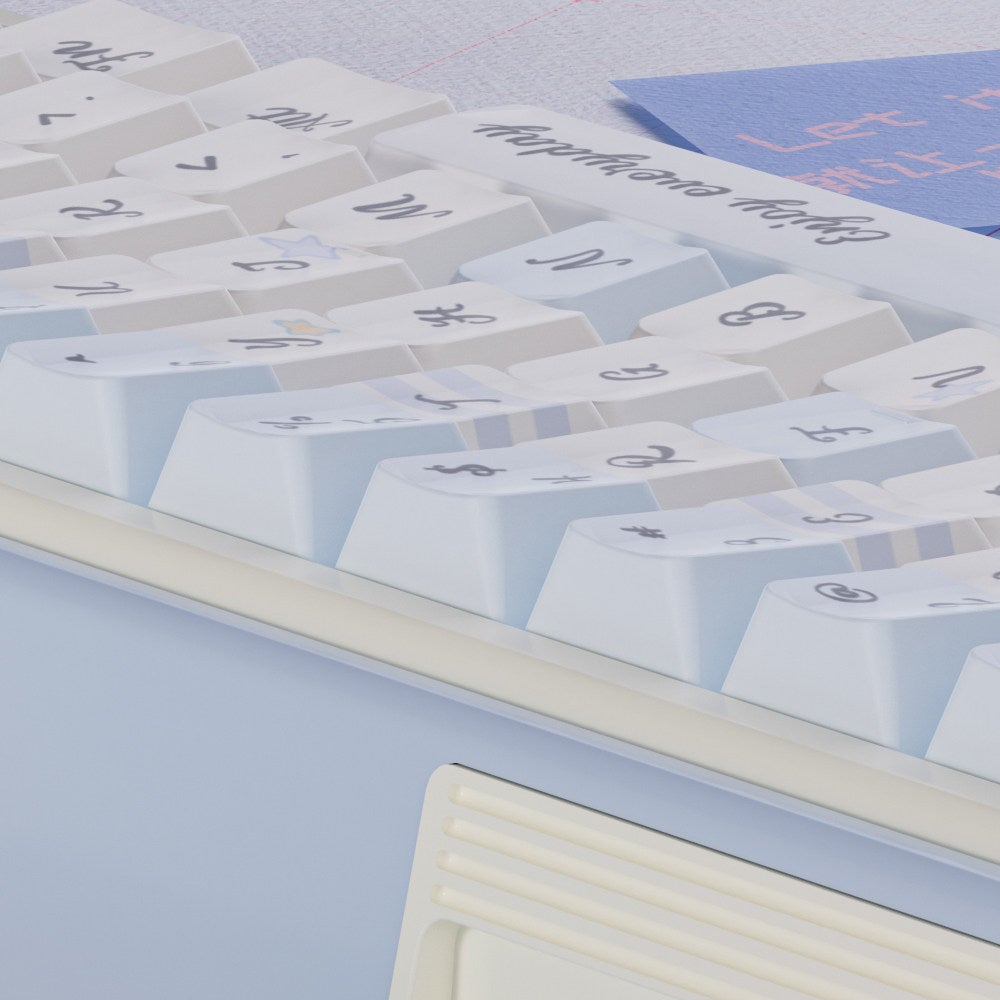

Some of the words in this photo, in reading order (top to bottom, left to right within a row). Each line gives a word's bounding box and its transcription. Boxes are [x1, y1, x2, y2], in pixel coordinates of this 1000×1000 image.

[247, 106, 353, 132] Alt
[473, 123, 731, 199] everyday
[729, 197, 891, 246] Enjoy
[525, 248, 633, 271] N
[718, 301, 805, 327] B
[606, 445, 696, 469] R
